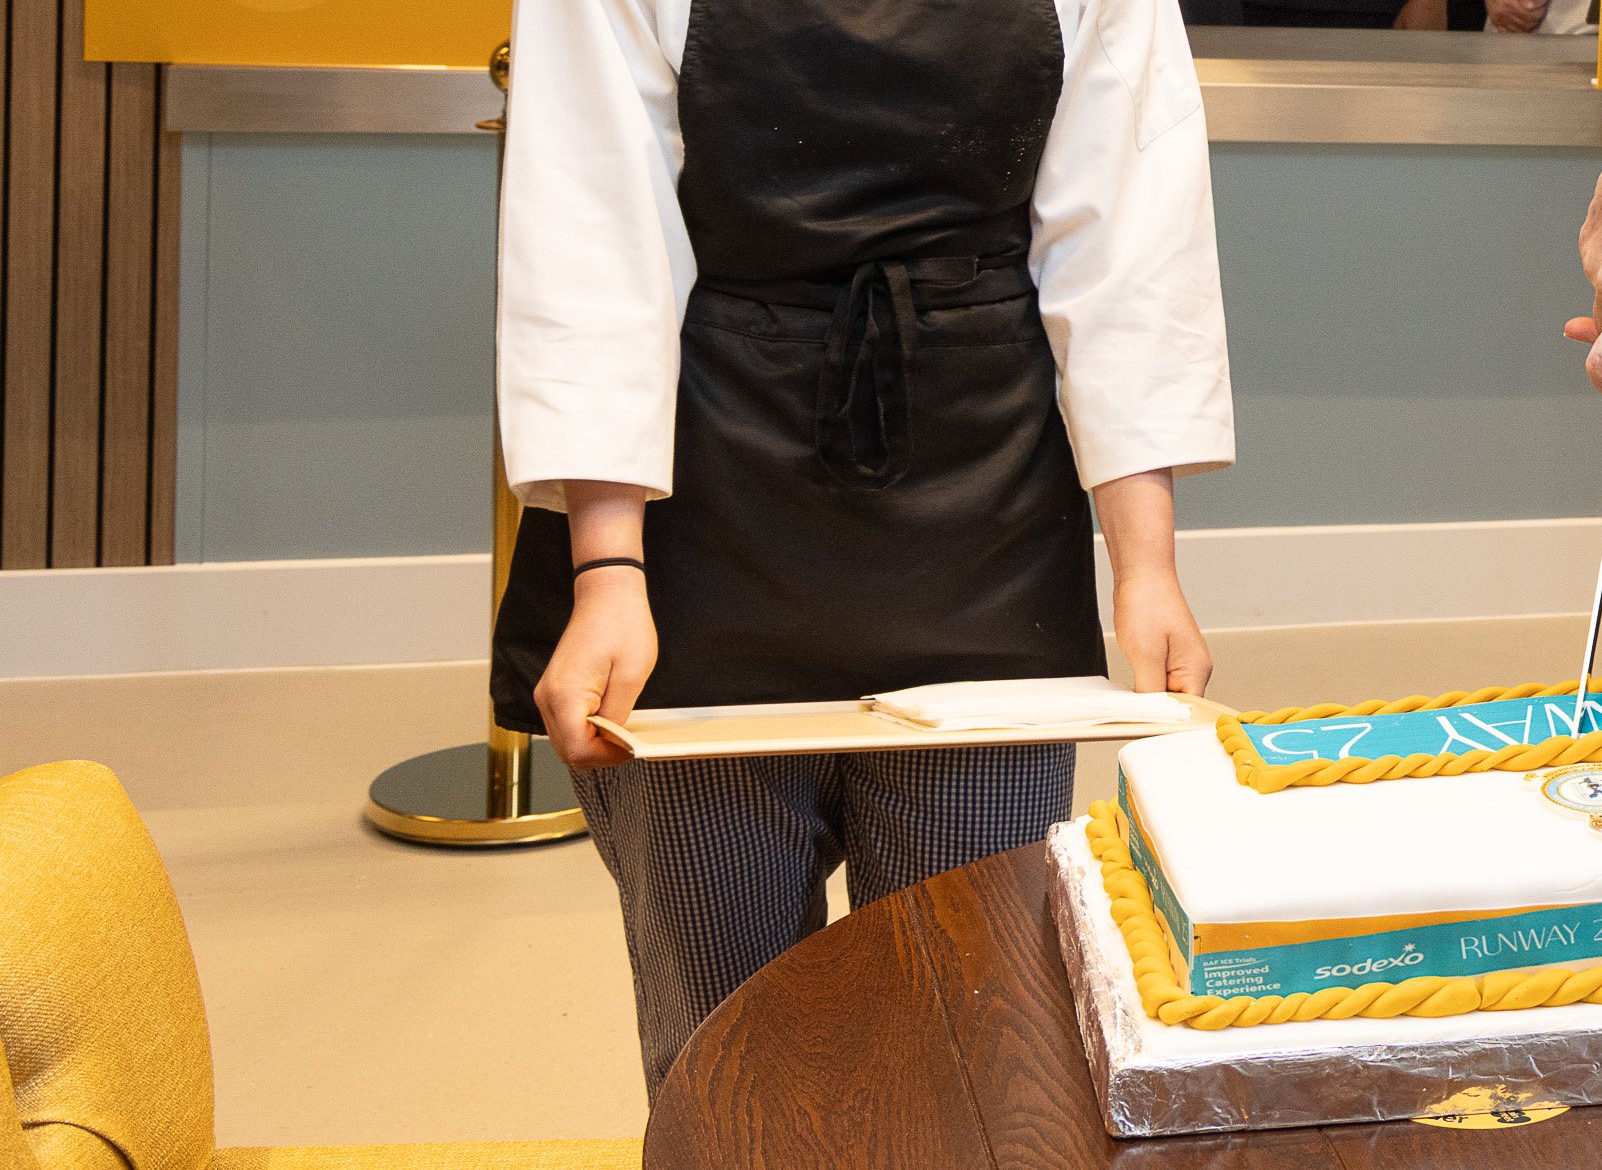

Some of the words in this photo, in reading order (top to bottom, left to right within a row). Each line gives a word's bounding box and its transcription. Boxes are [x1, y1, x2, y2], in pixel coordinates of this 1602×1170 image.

[1262, 723, 1372, 759] 25
[1459, 921, 1580, 961] RUNWAY
[1204, 964, 1270, 979] Improved
[1314, 943, 1424, 980] sodexo
[1205, 976, 1264, 988] Catering
[1206, 982, 1281, 996] Experience
